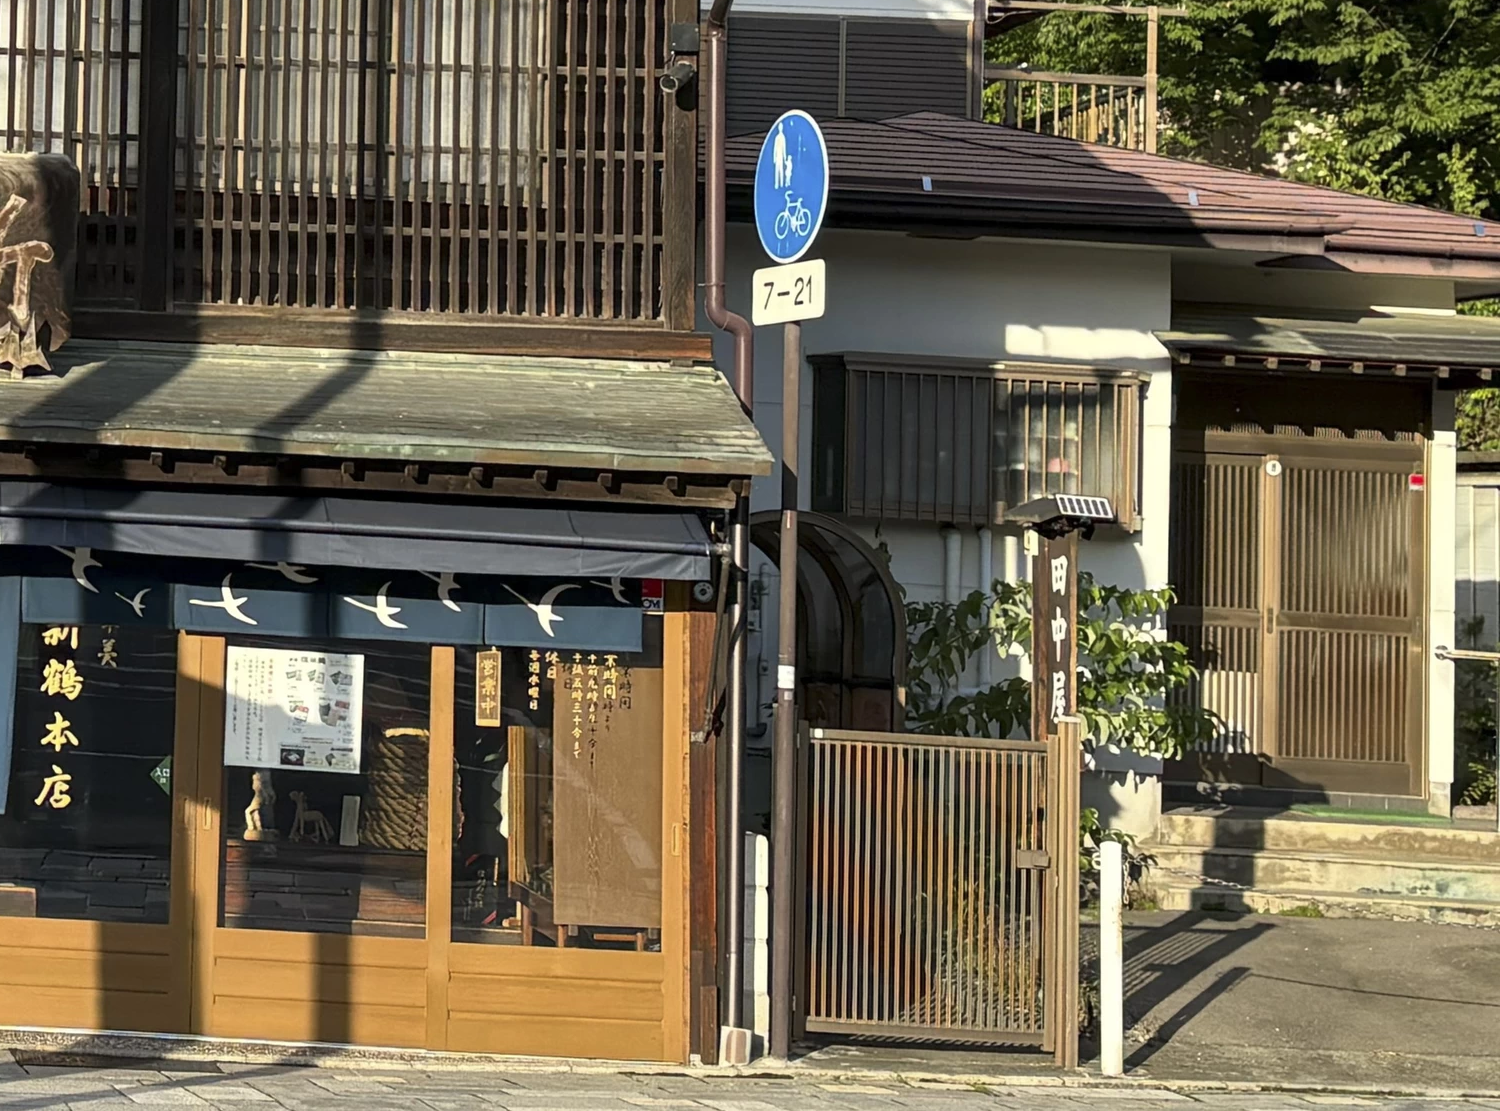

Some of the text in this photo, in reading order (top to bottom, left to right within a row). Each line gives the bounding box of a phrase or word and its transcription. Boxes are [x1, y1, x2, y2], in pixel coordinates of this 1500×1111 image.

[763, 275, 813, 310] 7-21
[1051, 554, 1068, 725] 田中屋
[480, 658, 497, 715] 営業中
